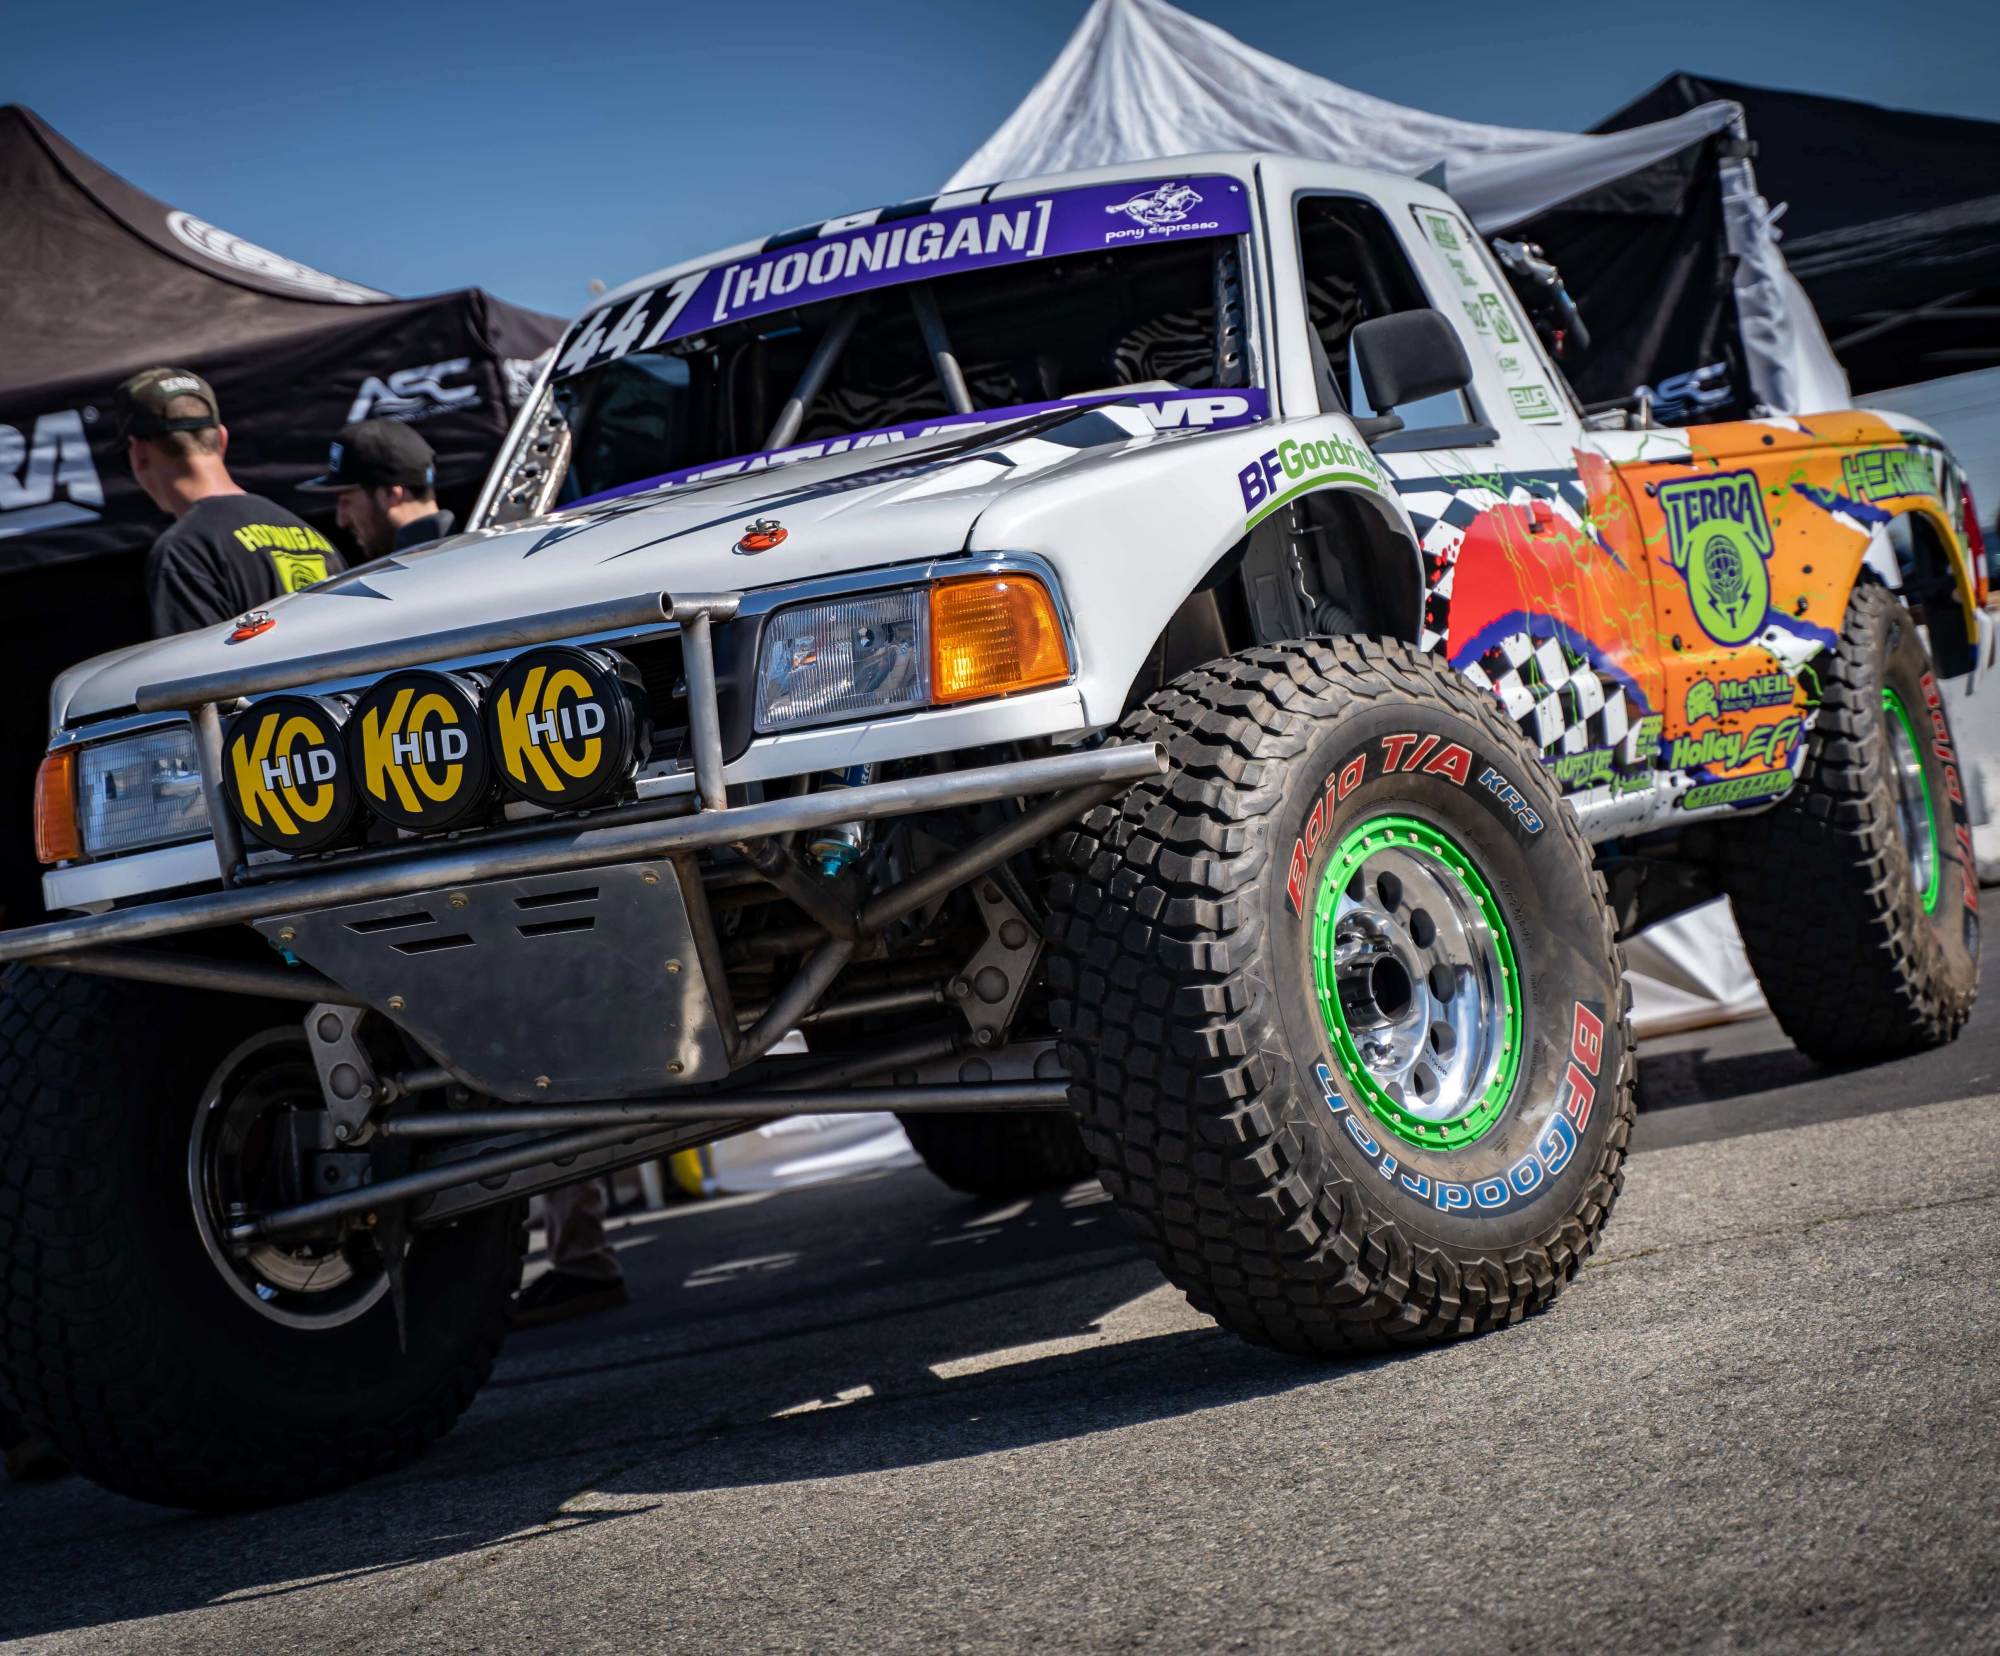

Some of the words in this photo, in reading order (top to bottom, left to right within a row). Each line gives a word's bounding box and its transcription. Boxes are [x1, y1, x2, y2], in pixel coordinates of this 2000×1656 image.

[1105, 228, 1145, 243] pony
[1148, 221, 1219, 236] espresso
[556, 269, 711, 375] 447
[1665, 482, 1767, 549] TERRA
[1719, 674, 1793, 700] McNEIL
[362, 688, 464, 813] KC
[392, 728, 469, 766] HID
[496, 666, 602, 792] KC
[526, 702, 606, 746] HID
[1670, 730, 1743, 770] Holley
[231, 713, 335, 835] KC
[260, 749, 337, 791] HID
[1287, 752, 1365, 919] Baja
[1381, 733, 1473, 787] T/A
[1477, 767, 1544, 834] KR3
[1316, 1000, 1603, 1211] BFGoodrich
